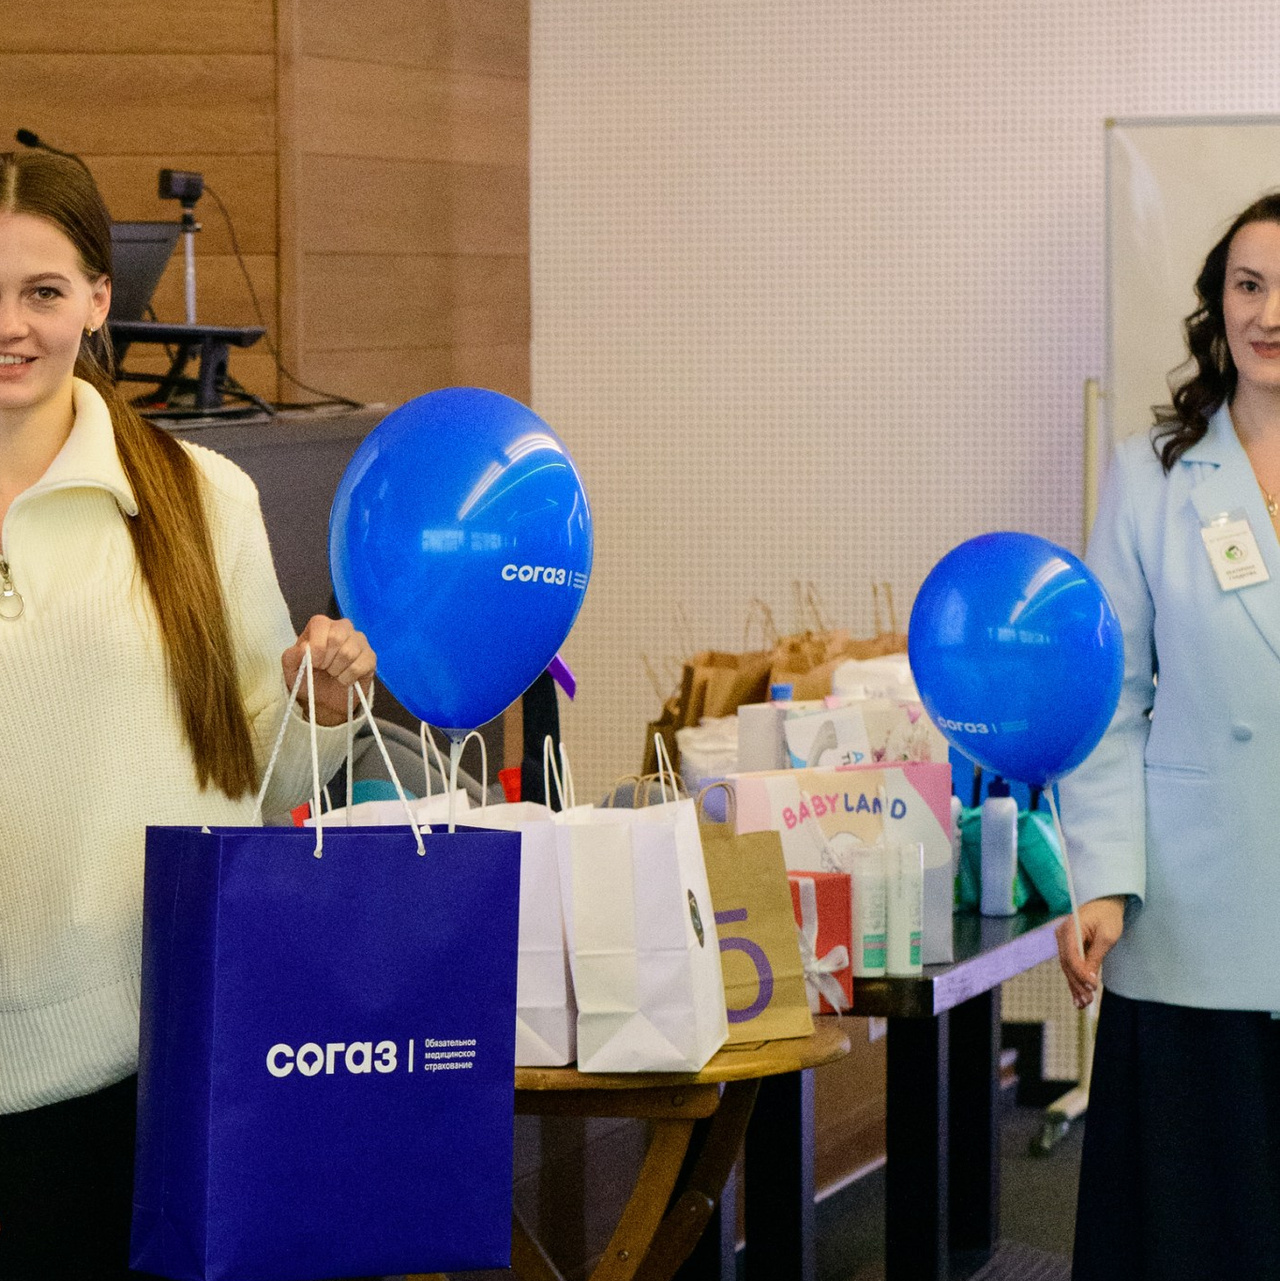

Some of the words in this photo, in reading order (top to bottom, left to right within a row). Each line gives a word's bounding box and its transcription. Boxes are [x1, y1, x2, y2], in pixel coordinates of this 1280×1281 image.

[501, 564, 567, 586] согаз
[782, 793, 839, 829] BABY
[843, 793, 907, 820] LAND
[266, 1040, 397, 1078] согаз
